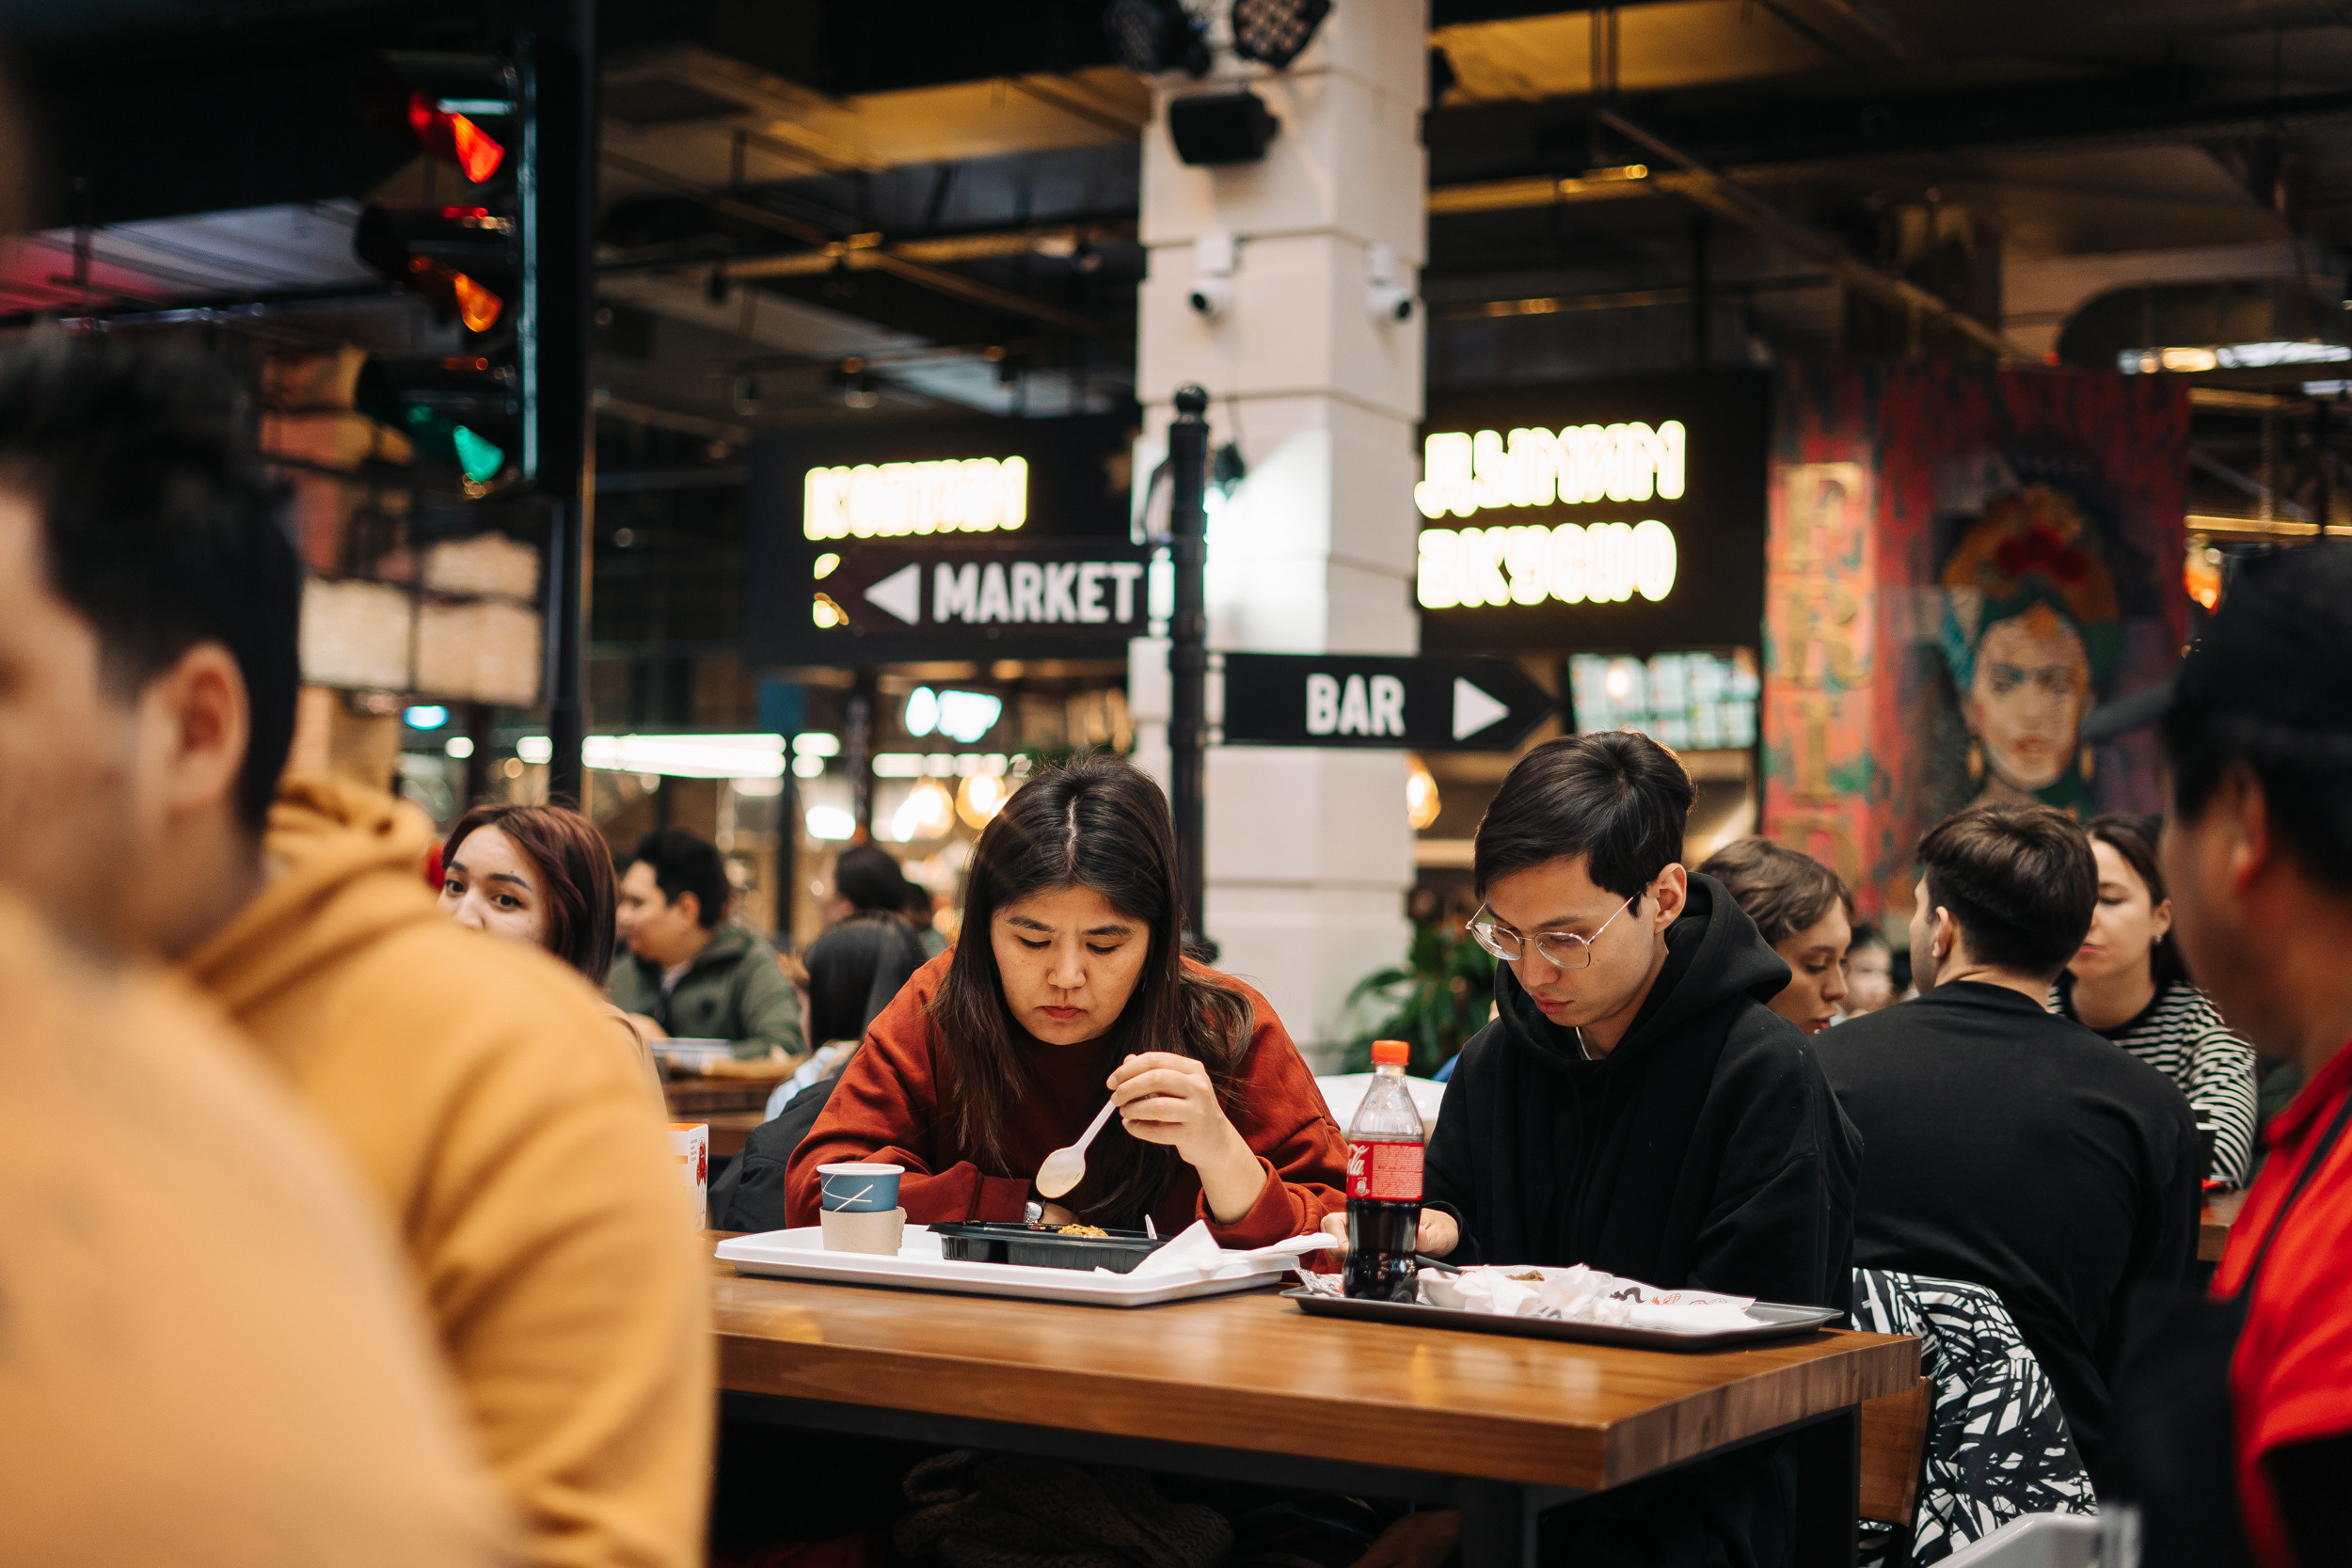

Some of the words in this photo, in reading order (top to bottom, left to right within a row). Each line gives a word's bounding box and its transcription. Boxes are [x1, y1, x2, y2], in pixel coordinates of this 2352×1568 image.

[1414, 420, 1686, 519] ДЫМИМ
[932, 562, 1143, 625] MARKET
[1417, 519, 1677, 610] ВКУСНО
[1305, 673, 1406, 736] BAR
